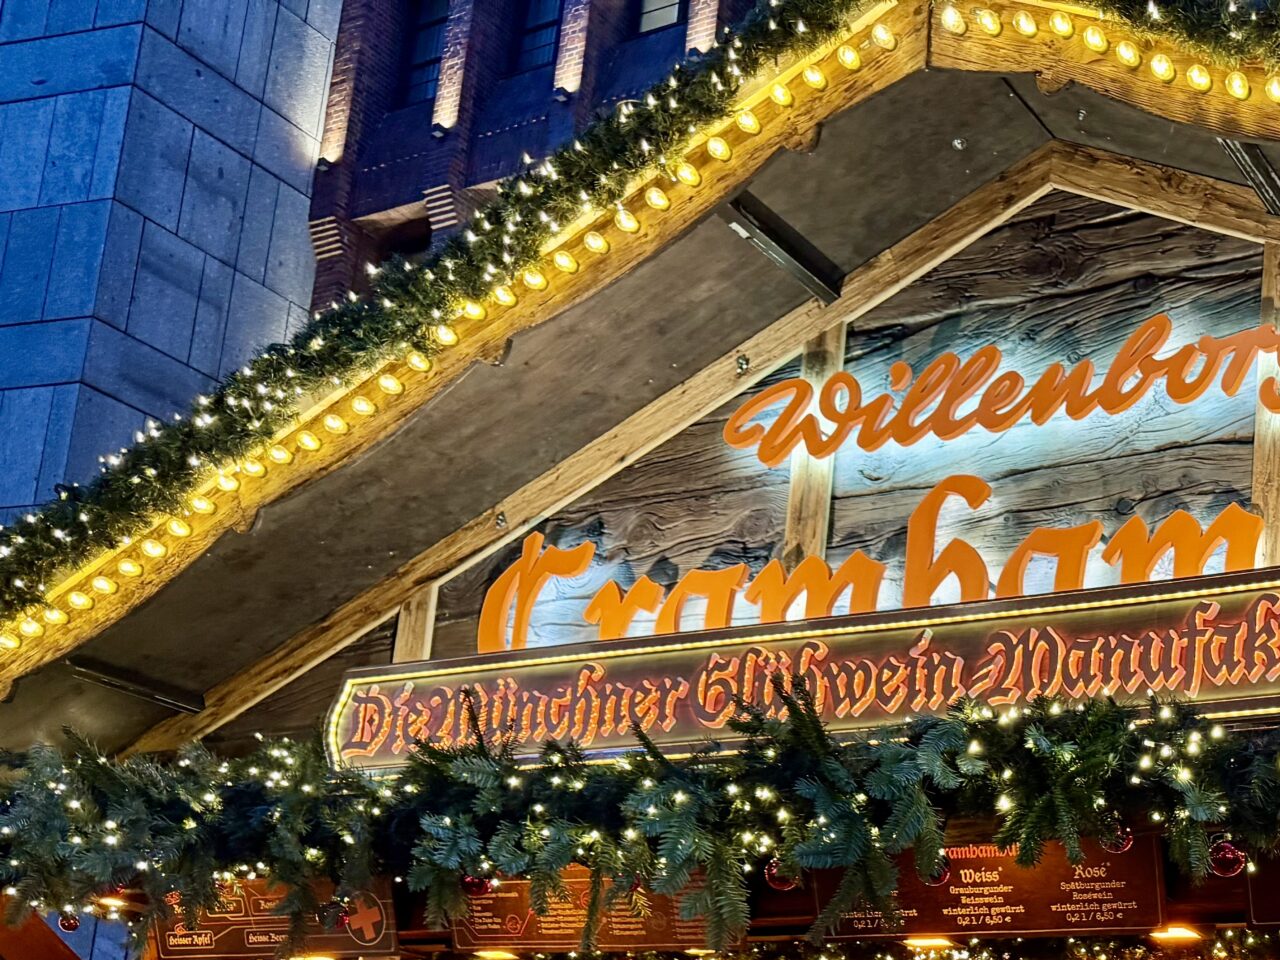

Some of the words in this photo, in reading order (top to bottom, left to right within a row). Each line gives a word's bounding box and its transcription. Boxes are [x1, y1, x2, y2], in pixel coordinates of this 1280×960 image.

[341, 681, 432, 758] Die
[950, 885, 1014, 895] Grauburgunder
[1060, 880, 1126, 892] Spätburgunder
[1072, 891, 1114, 900] Roséwein
[942, 905, 989, 915] winterlich
[991, 904, 1025, 916] gewürzt
[1050, 902, 1100, 912] winterlich
[1102, 901, 1138, 912] gewürzt
